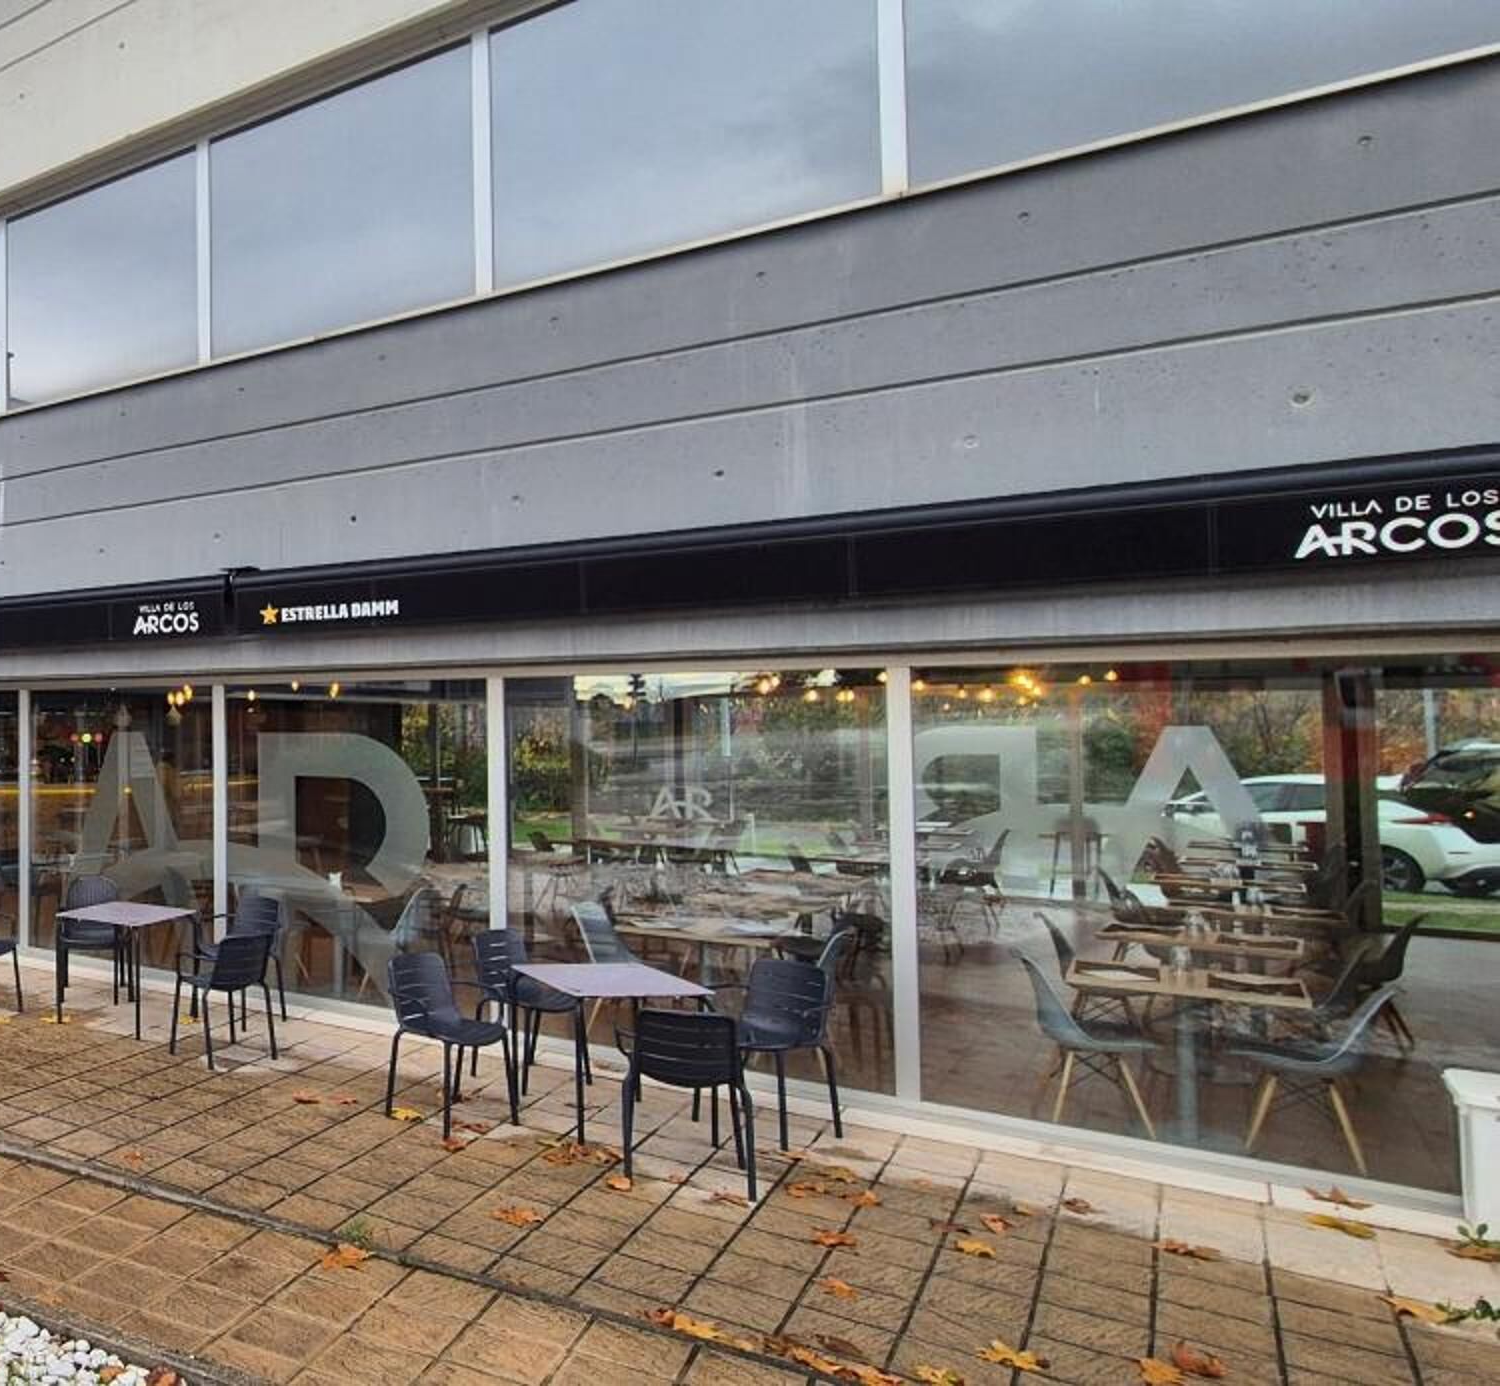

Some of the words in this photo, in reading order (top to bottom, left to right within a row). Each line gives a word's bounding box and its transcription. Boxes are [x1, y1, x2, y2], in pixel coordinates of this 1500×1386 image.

[1310, 500, 1382, 519] VILLA
[1395, 494, 1431, 513] DE
[1446, 489, 1499, 508] LOS
[281, 603, 349, 622] ESTRELLA
[351, 600, 399, 618] DAMM
[133, 612, 199, 635] ARCOS
